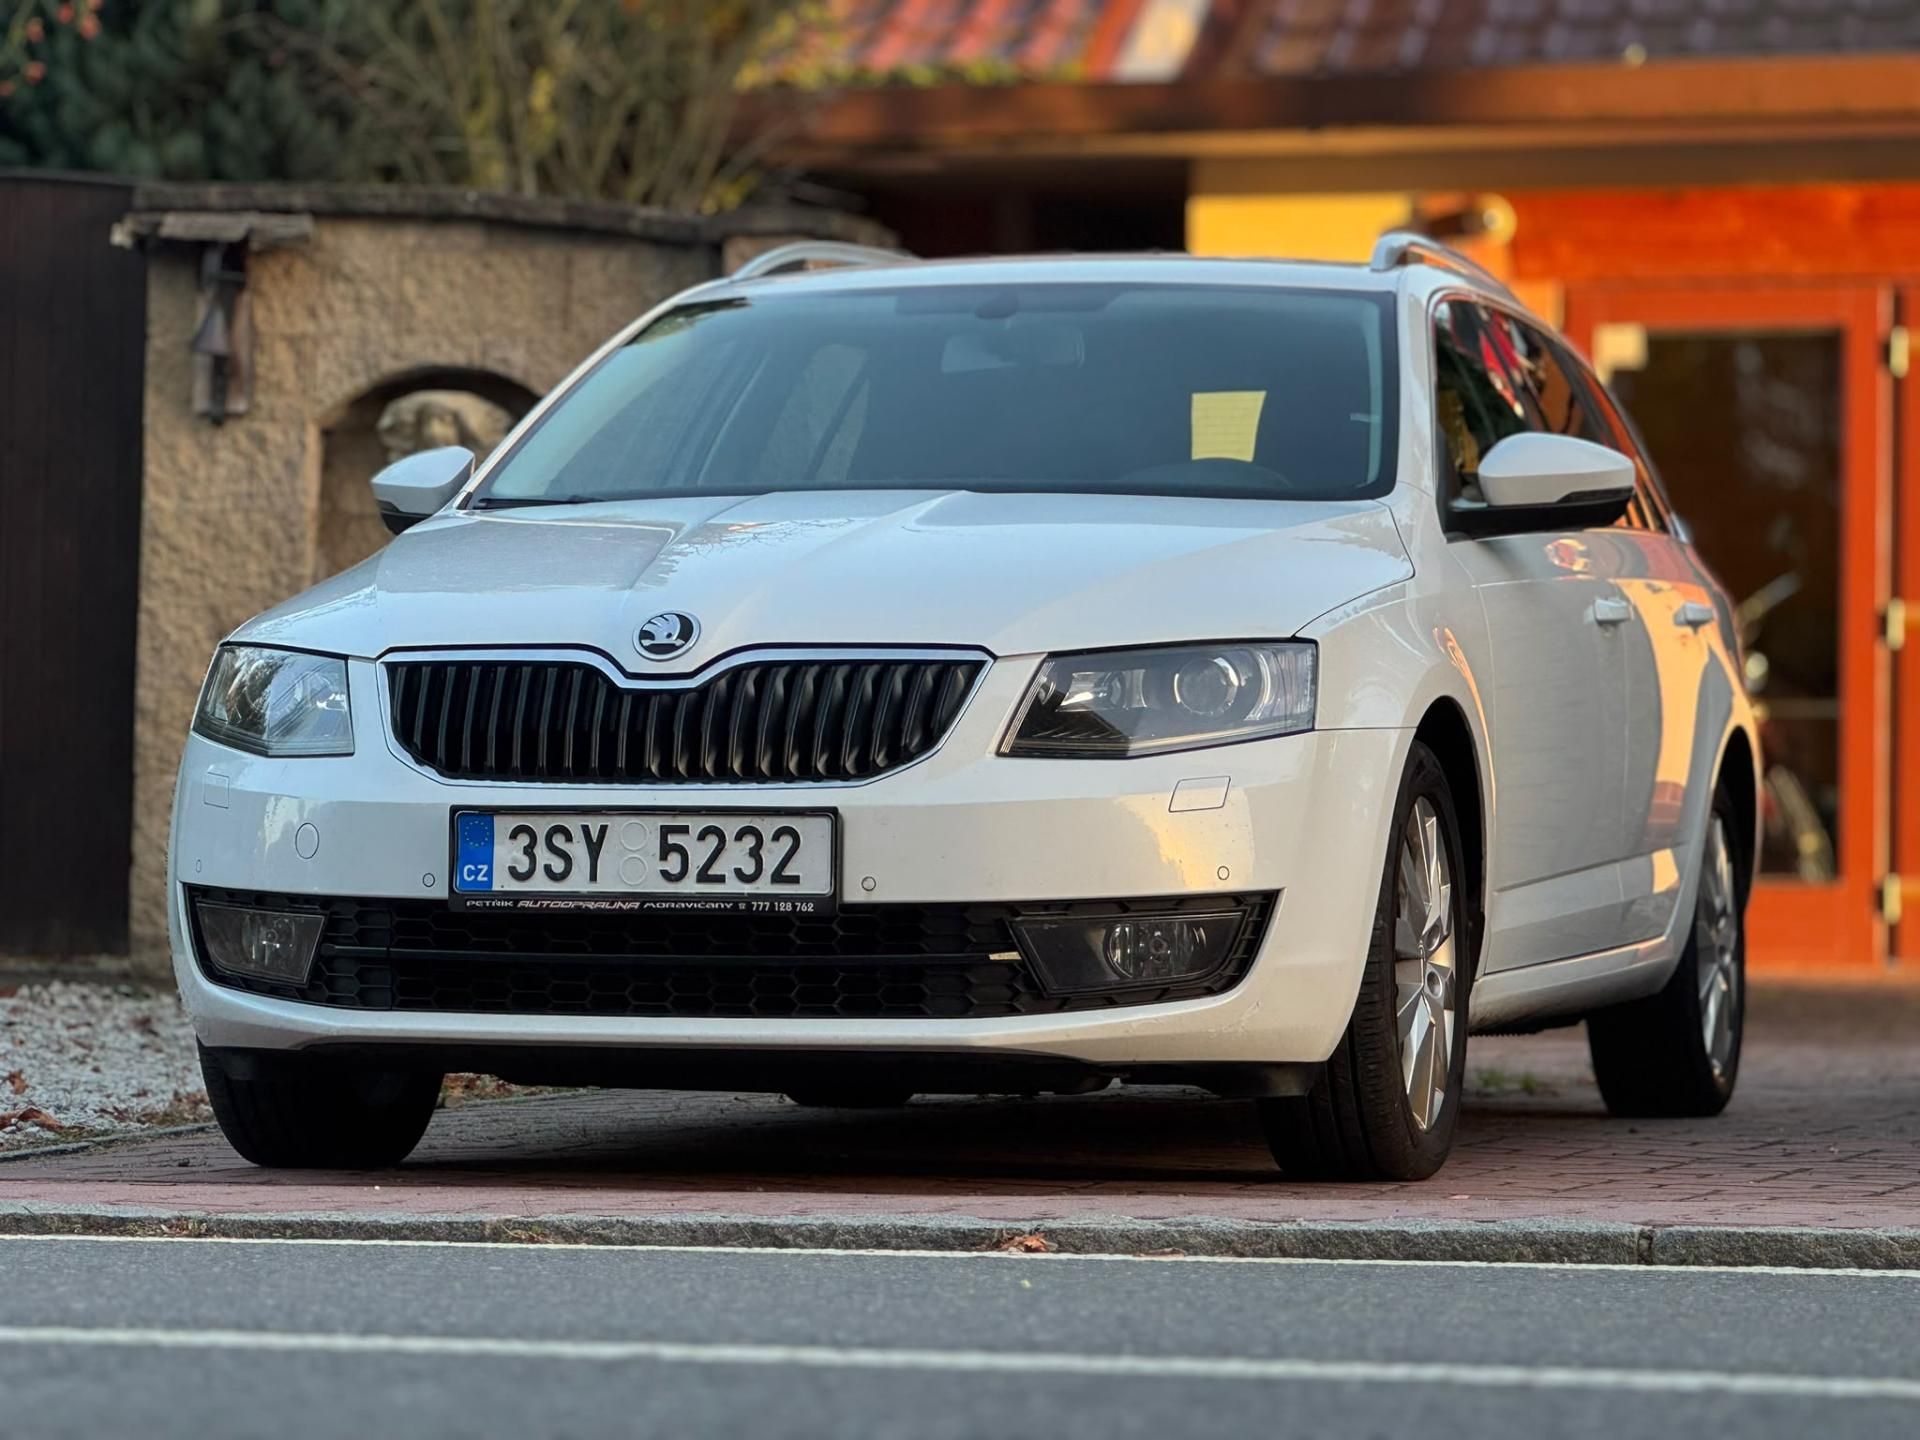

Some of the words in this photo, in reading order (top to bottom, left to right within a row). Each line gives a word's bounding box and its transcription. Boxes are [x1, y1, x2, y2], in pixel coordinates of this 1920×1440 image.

[508, 824, 608, 883] 3SY
[659, 824, 801, 885] 5232
[463, 864, 488, 882] CZ
[751, 902, 770, 911] 777
[774, 902, 792, 912] 128
[795, 902, 814, 912] 762
